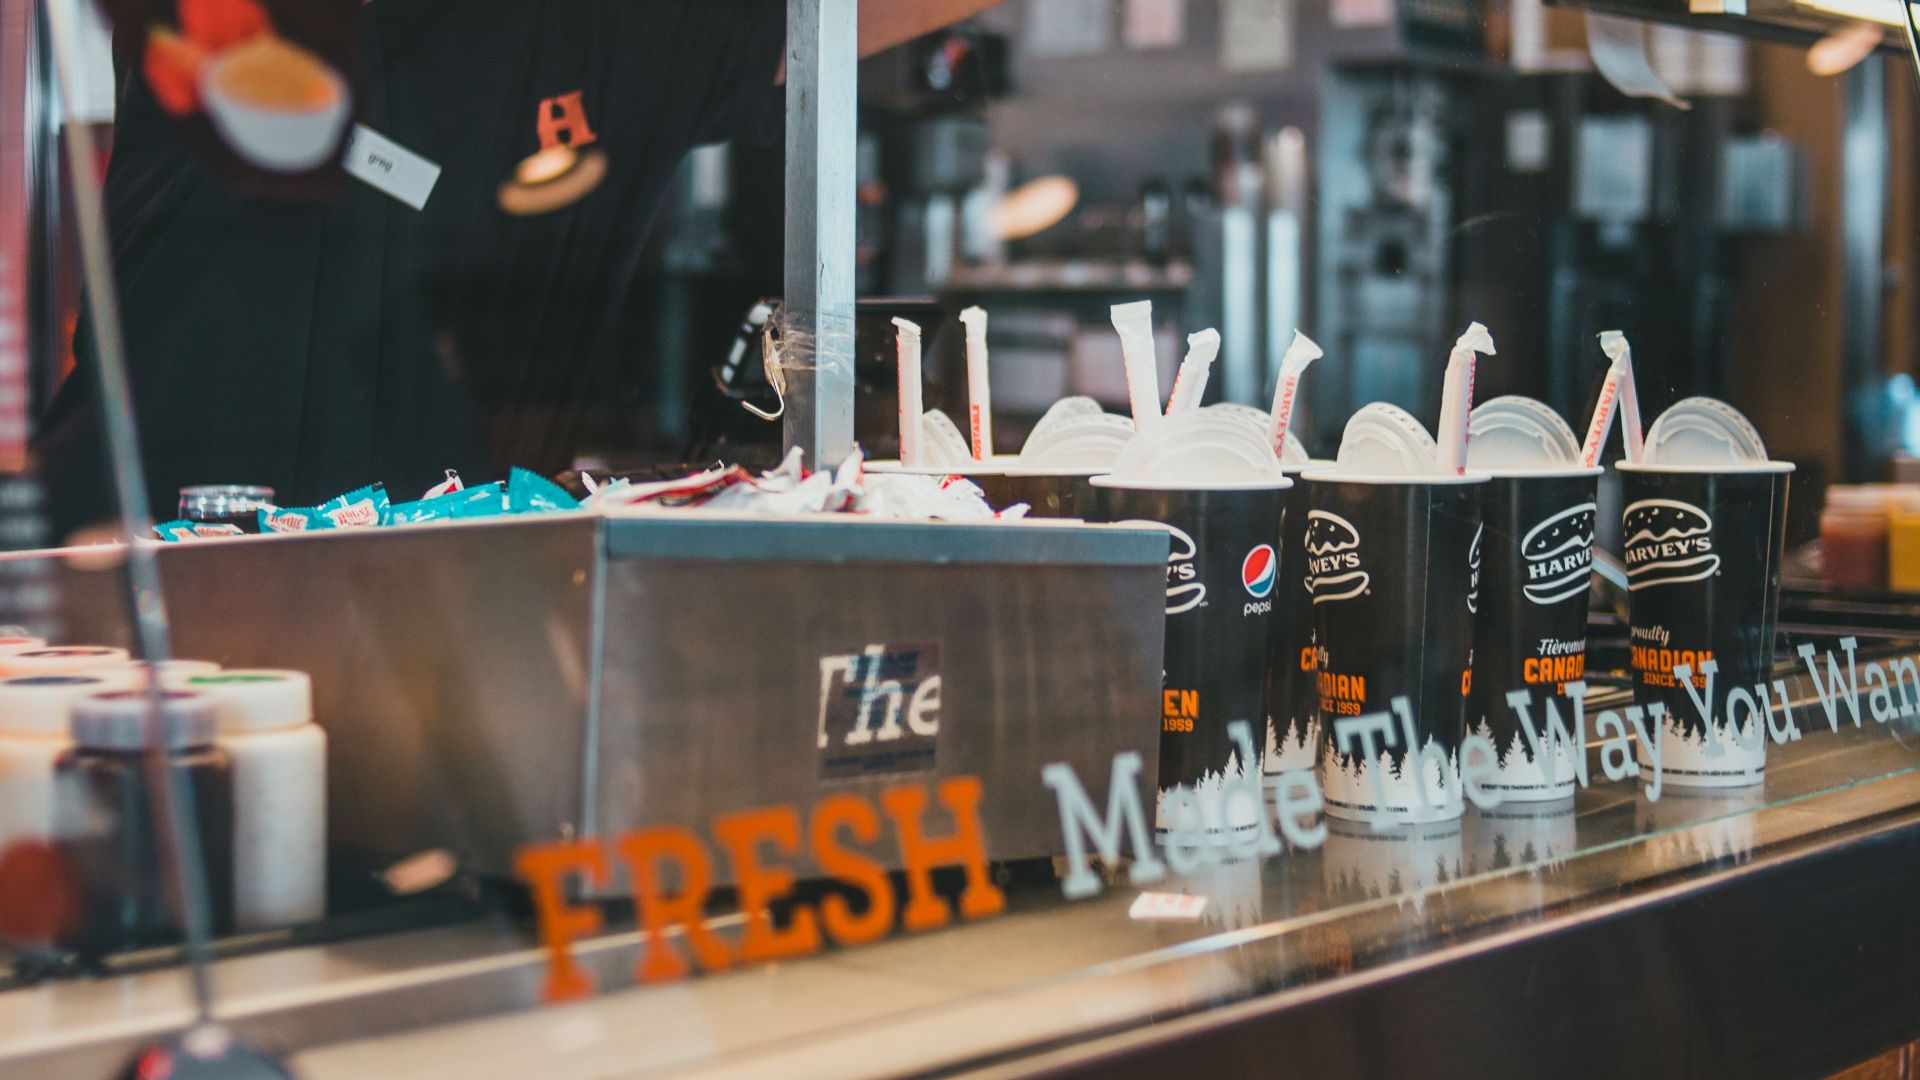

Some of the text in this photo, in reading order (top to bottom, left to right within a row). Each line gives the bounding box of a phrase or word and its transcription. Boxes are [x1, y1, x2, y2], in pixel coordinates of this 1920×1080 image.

[537, 89, 597, 151] H
[970, 404, 982, 461] POSTABLE
[1309, 551, 1361, 575] VEY'S
[1528, 545, 1592, 580] HARVE
[1624, 536, 1712, 565] ARVEY'S
[1243, 599, 1272, 617] pepsi
[1631, 624, 1670, 648] roudly
[1523, 652, 1585, 684] CANAD
[1630, 644, 1713, 674] ANADIAN
[1643, 671, 1676, 688] SINCE
[816, 643, 942, 749] The
[1336, 700, 1361, 717] 1959
[1163, 717, 1195, 733] 1959
[514, 635, 1920, 1007] FRESH Made The Way You Wan
